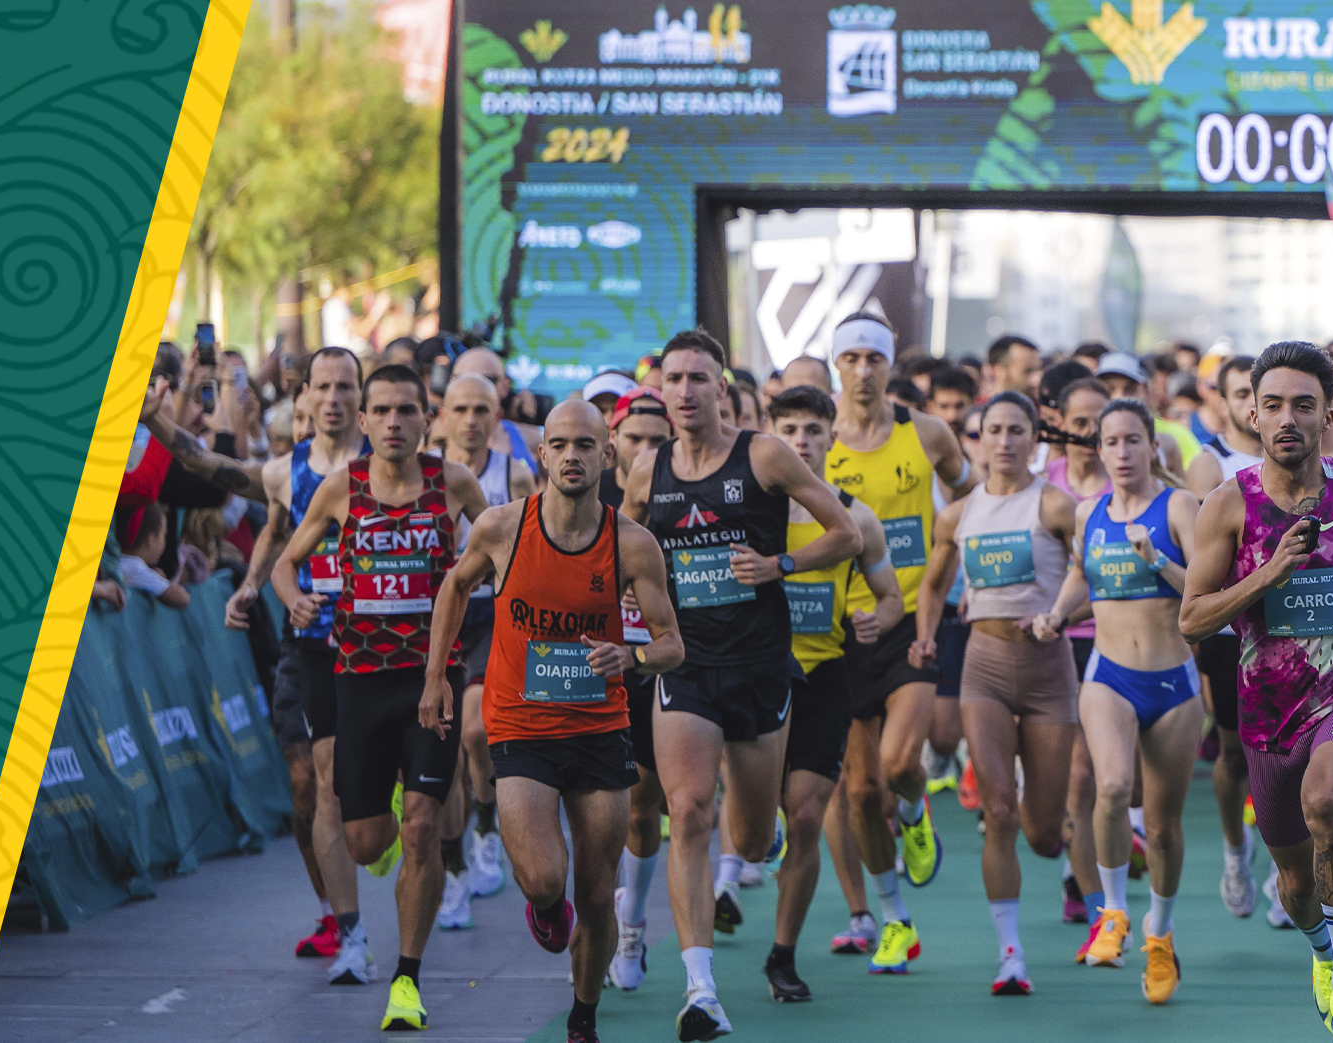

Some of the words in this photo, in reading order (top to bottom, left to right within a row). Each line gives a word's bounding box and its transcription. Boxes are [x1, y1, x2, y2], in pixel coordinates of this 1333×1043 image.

[481, 91, 595, 115] DONOSTIA
[597, 91, 610, 115] /
[610, 91, 658, 115] SAN
[660, 88, 783, 115] SEBASTIÁN
[542, 127, 629, 163] 2024
[354, 529, 441, 552] KENYA
[979, 550, 1013, 566] LOYO
[994, 565, 1001, 576] 1
[1100, 562, 1137, 577] SOLER
[372, 574, 410, 595] 121
[1114, 576, 1122, 587] 2
[1292, 576, 1319, 585] RURAL
[709, 582, 717, 594] 5
[1307, 610, 1315, 622] 2
[554, 648, 579, 656] RURAL
[535, 664, 597, 678] OIARBID
[564, 679, 572, 690] 6
